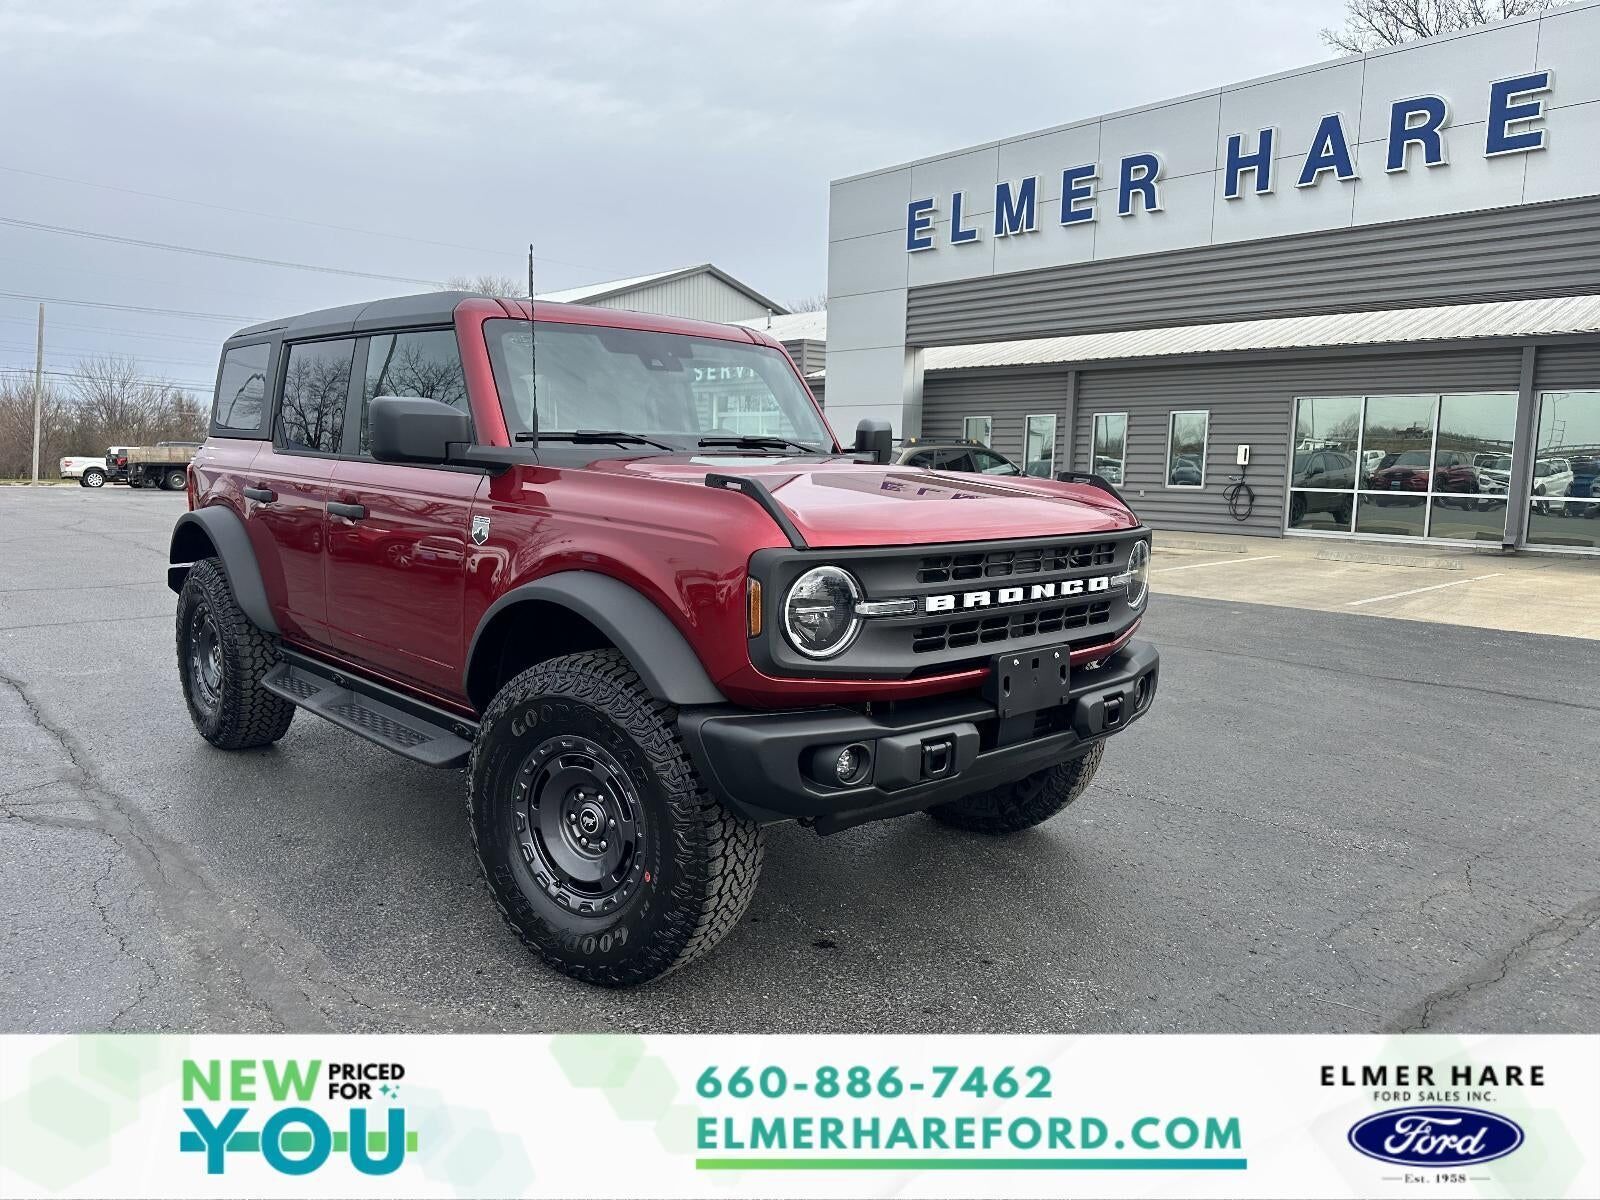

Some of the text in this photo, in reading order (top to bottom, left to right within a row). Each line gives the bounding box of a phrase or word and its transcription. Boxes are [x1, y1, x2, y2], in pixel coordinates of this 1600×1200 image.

[906, 70, 1553, 252] ELMER HARE
[925, 576, 1109, 612] BRONCO
